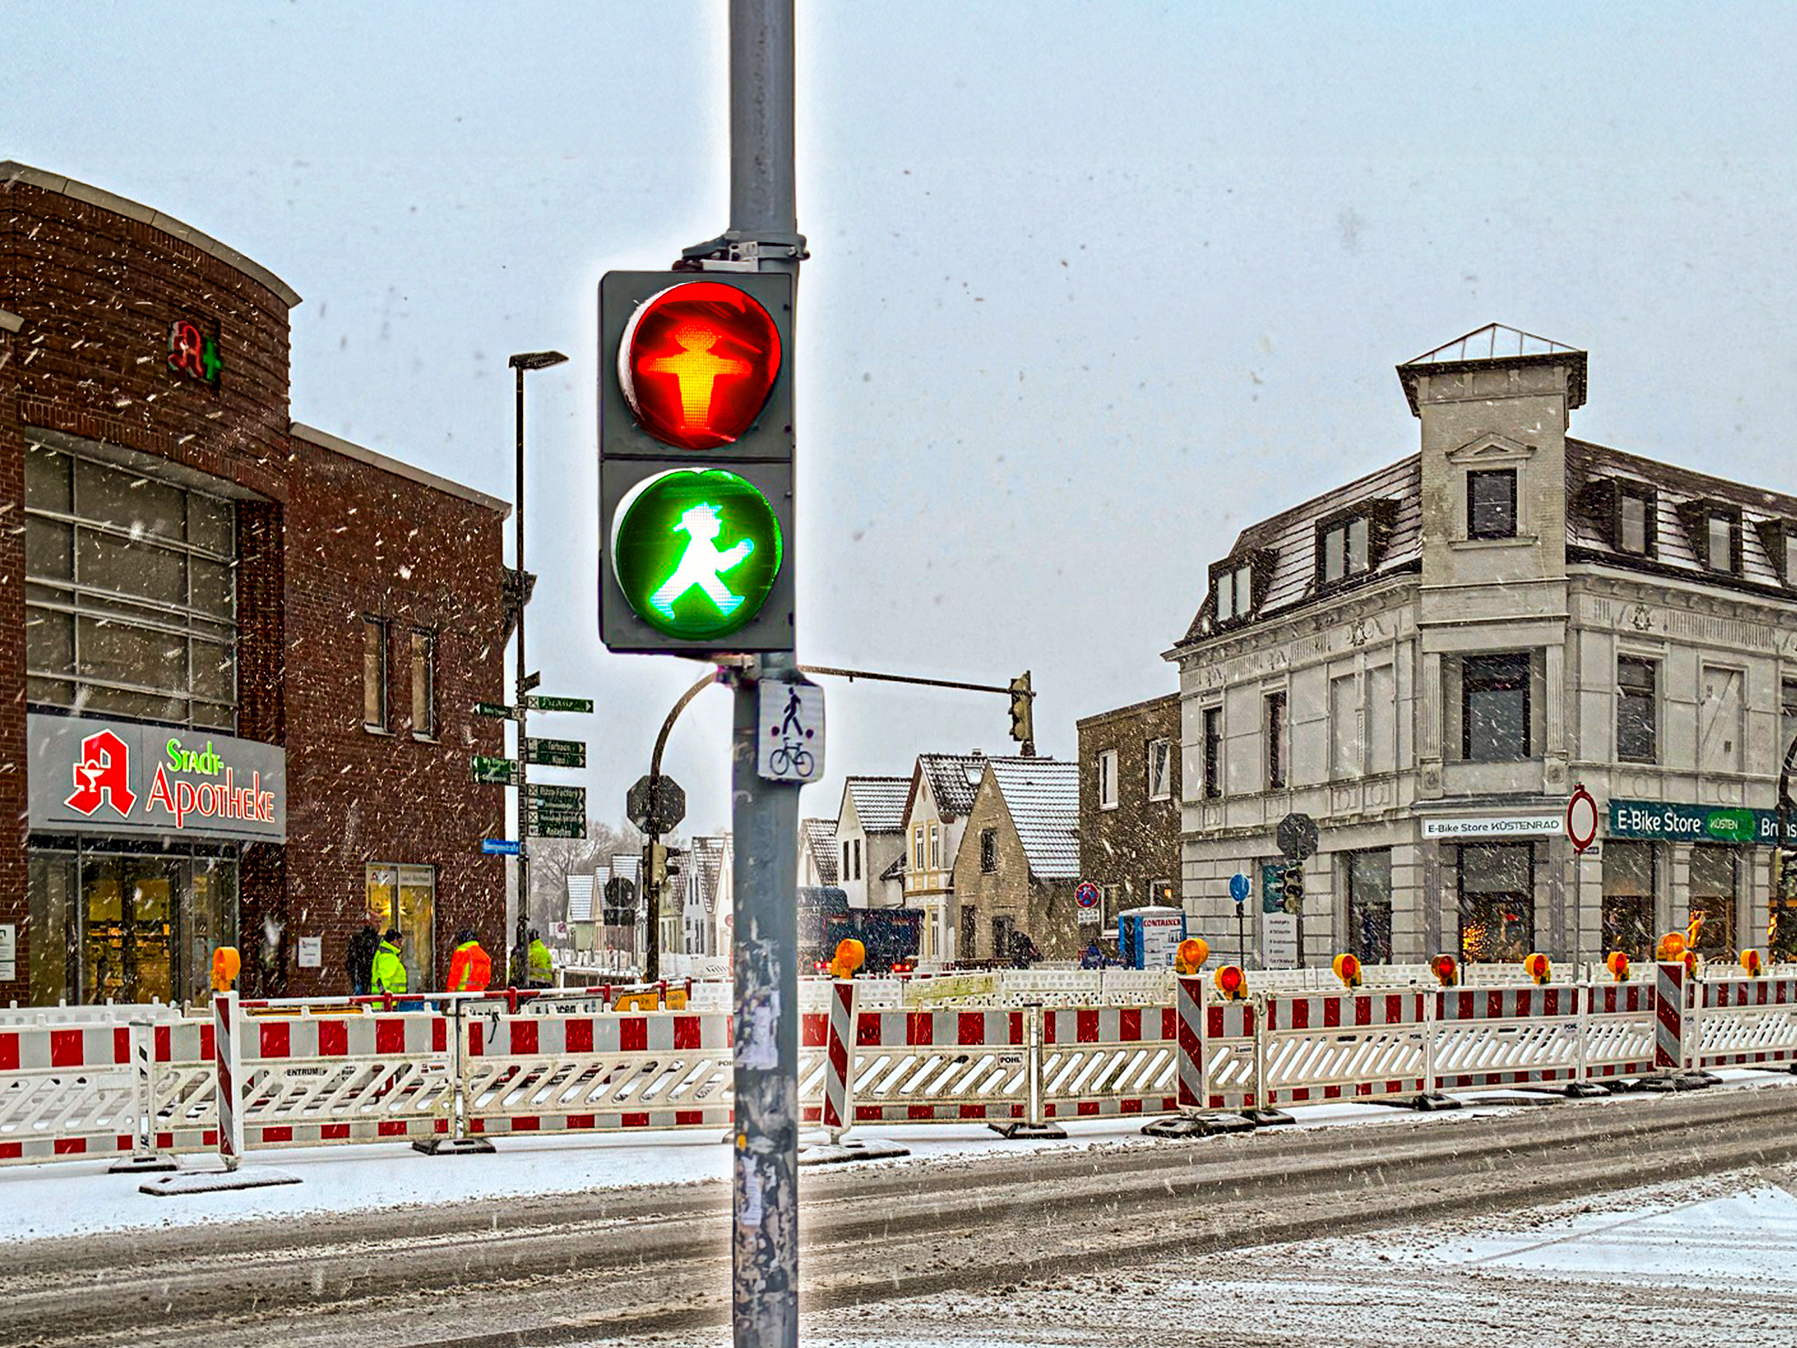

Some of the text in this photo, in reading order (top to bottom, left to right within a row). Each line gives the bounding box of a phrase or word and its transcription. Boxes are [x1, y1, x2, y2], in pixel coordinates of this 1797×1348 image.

[145, 760, 276, 829] Apotheke
[1428, 820, 1560, 833] E-Bike Store KÜSTENRAD
[1617, 809, 1661, 831] E-Bike
[1663, 812, 1701, 833] Store
[1761, 817, 1797, 838] Brs
[1000, 1056, 1021, 1064] POHL
[285, 1062, 319, 1077] ENTRUM
